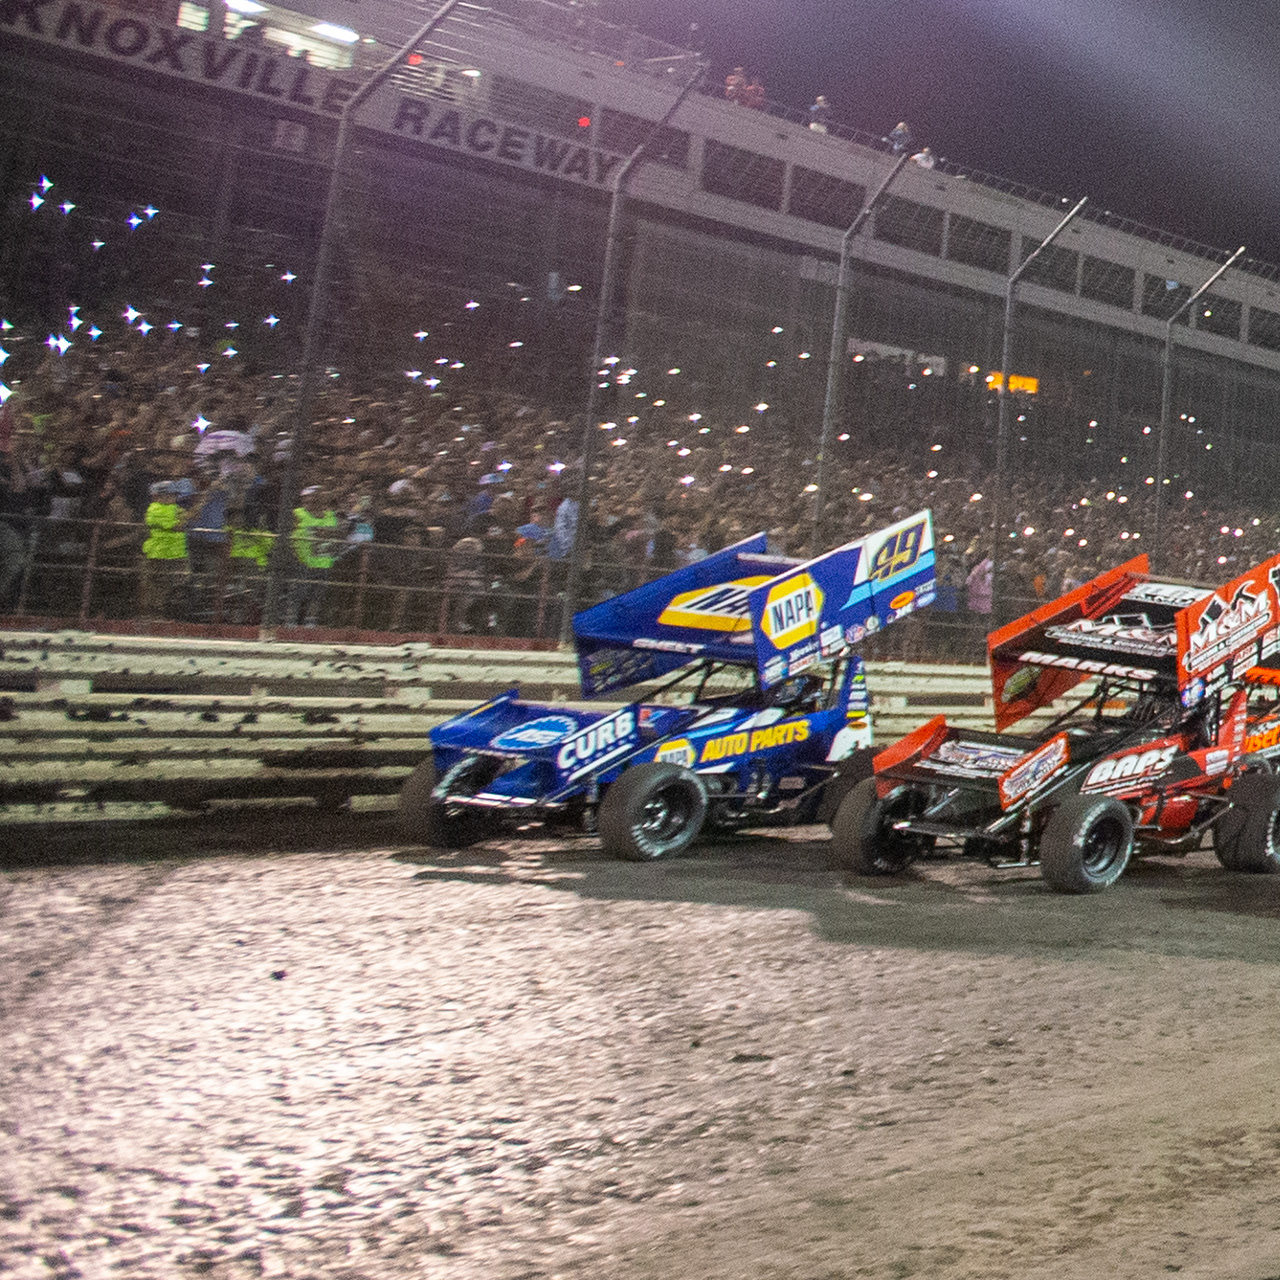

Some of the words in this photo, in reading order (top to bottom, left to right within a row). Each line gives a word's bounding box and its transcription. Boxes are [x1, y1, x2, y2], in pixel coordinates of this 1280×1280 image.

[394, 95, 623, 184] RACEWAY
[868, 520, 928, 582] 49
[770, 589, 814, 634] NAPA
[1190, 590, 1268, 654] M&M
[1018, 650, 1159, 680] MARKS
[557, 711, 635, 769] CURB
[700, 731, 750, 762] AUTO
[750, 719, 810, 752] PARTS
[1087, 744, 1180, 785] BAPS
